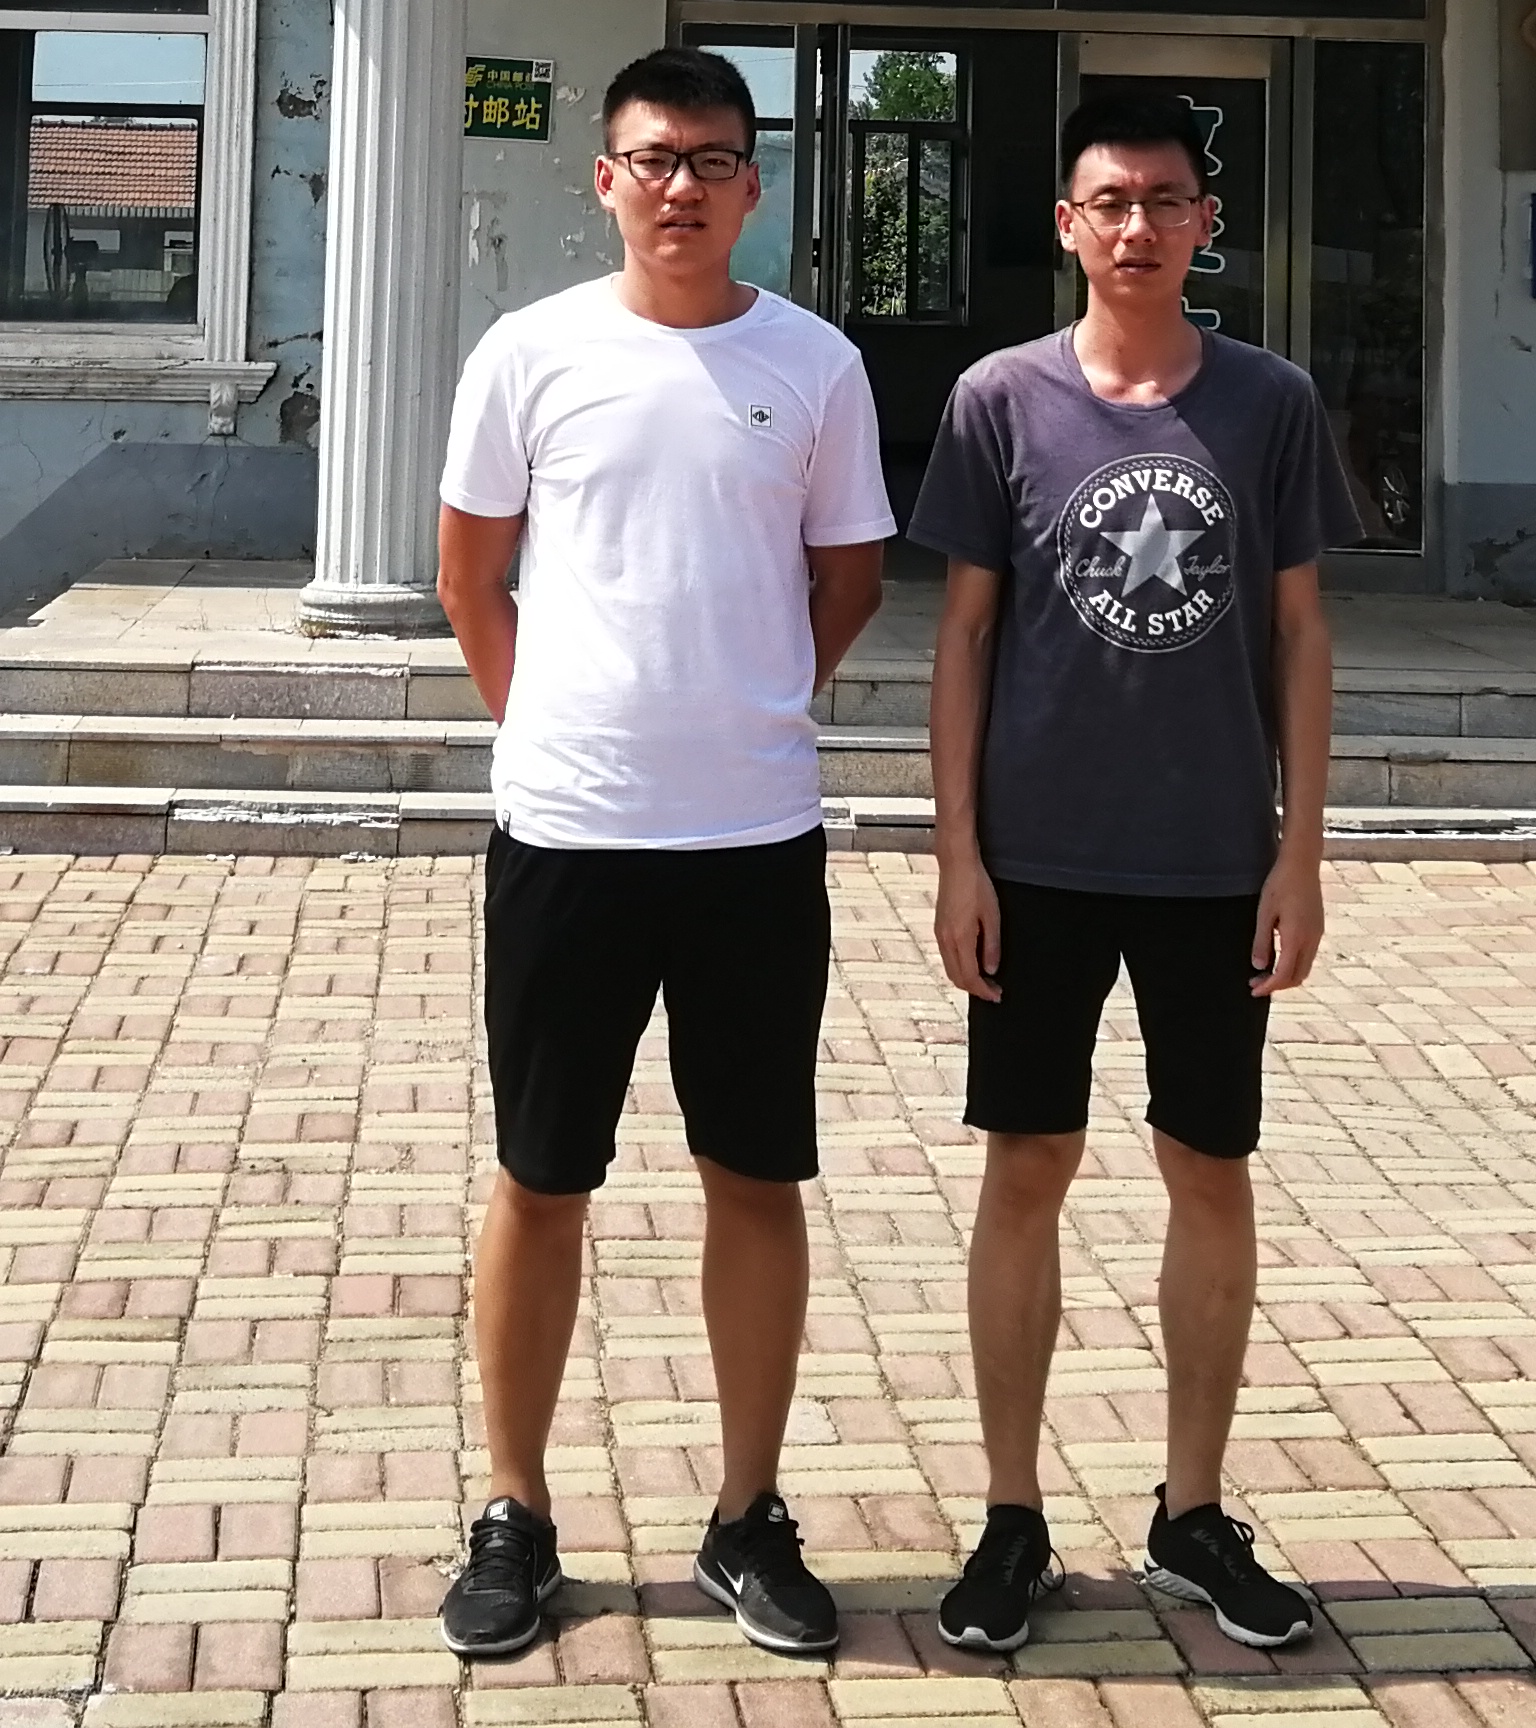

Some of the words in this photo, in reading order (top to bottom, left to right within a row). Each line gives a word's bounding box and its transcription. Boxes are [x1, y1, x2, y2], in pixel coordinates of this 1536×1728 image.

[1079, 468, 1224, 529] CONVERSE
[1075, 556, 1126, 578] Chuck
[1183, 554, 1230, 582] Taylor
[1088, 589, 1137, 633] ALL
[1148, 588, 1215, 636] STAR
